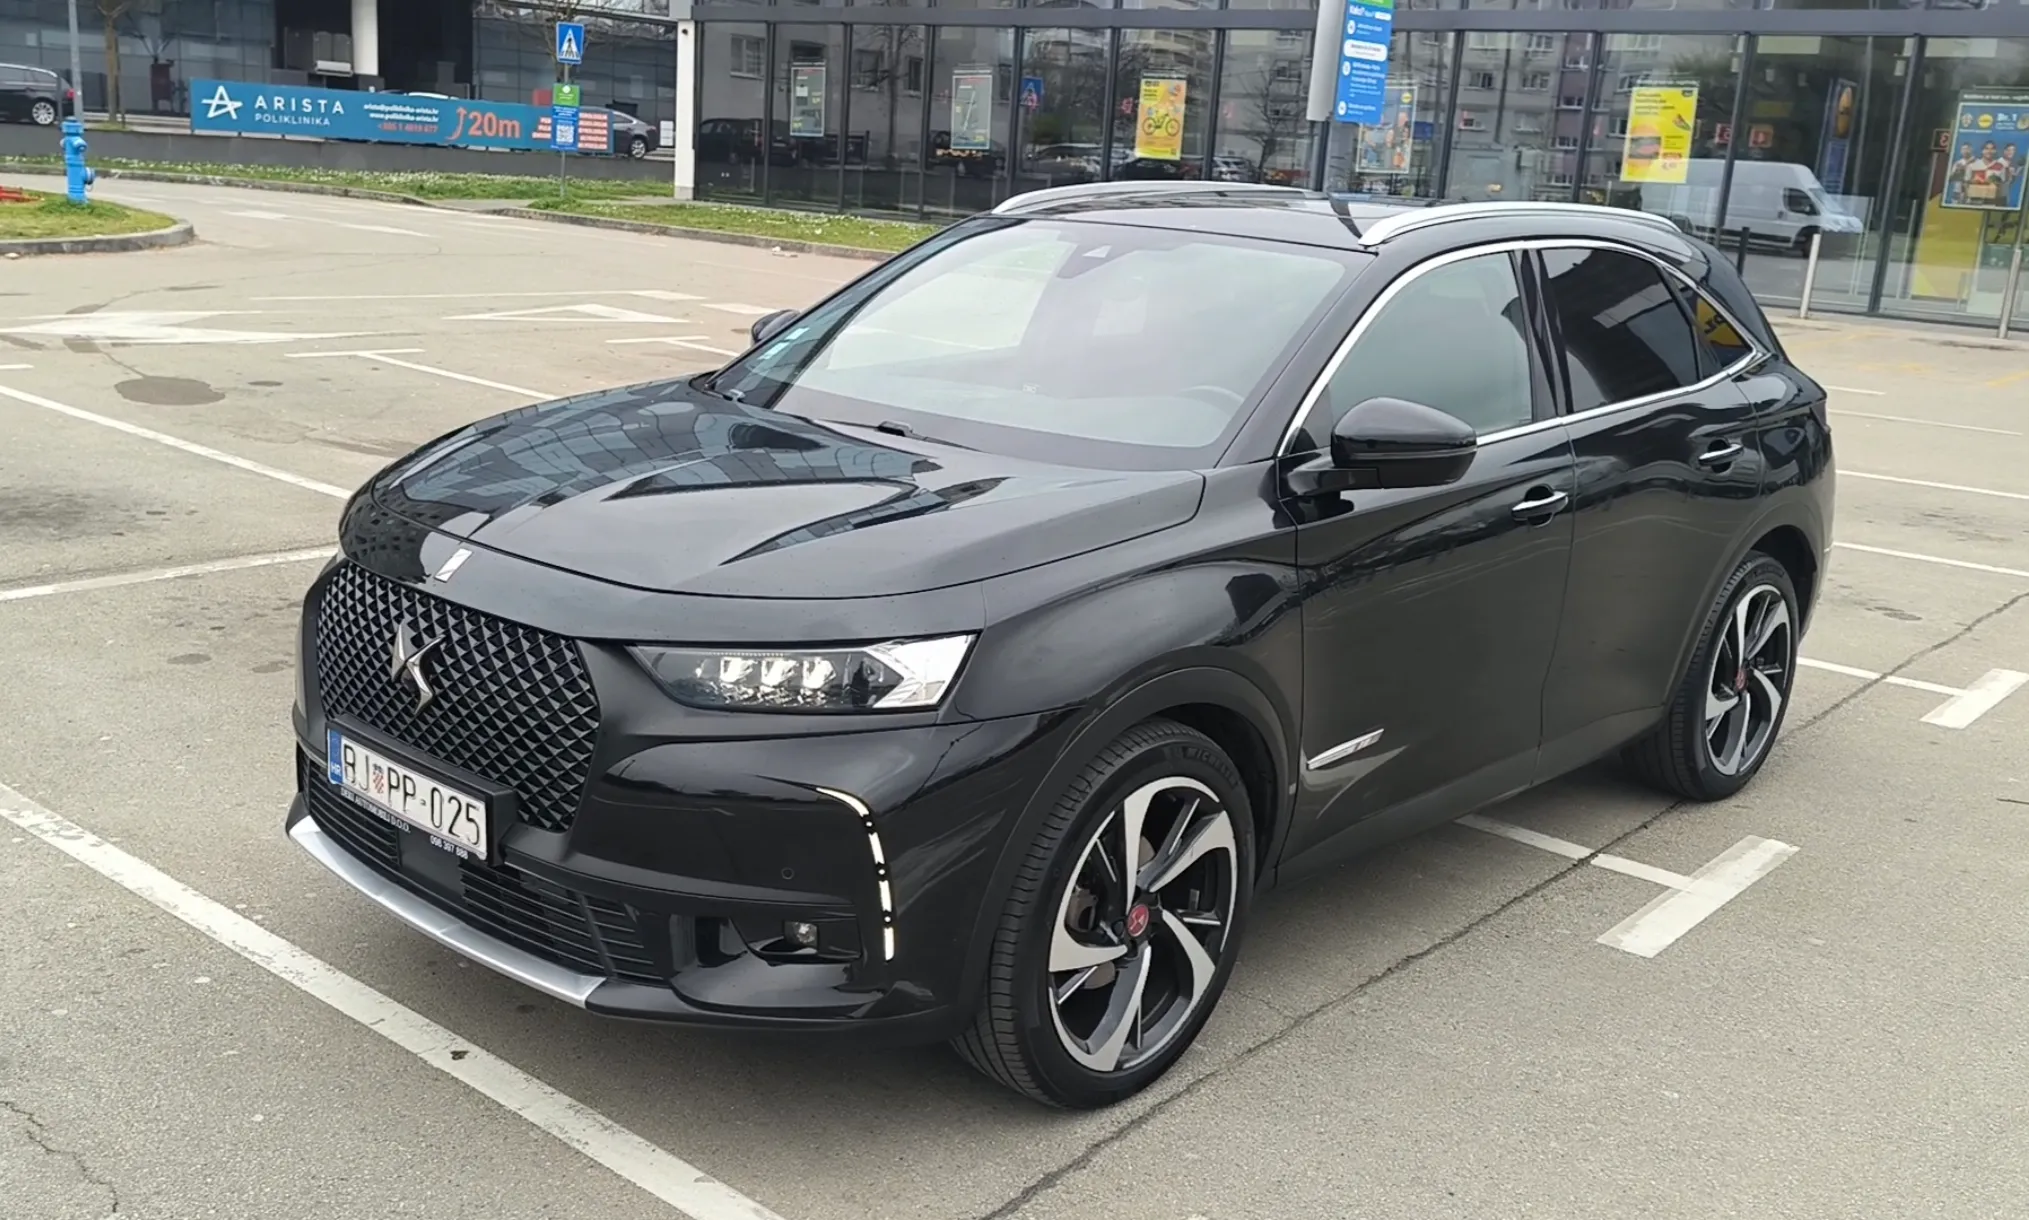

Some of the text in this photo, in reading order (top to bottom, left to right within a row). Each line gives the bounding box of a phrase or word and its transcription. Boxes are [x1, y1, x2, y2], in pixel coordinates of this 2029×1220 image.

[254, 95, 345, 115] ARISTA
[254, 113, 331, 127] POLIKLINIKA
[468, 111, 521, 139] 20m
[331, 761, 341, 777] HR
[344, 745, 481, 846] BJ PP-025
